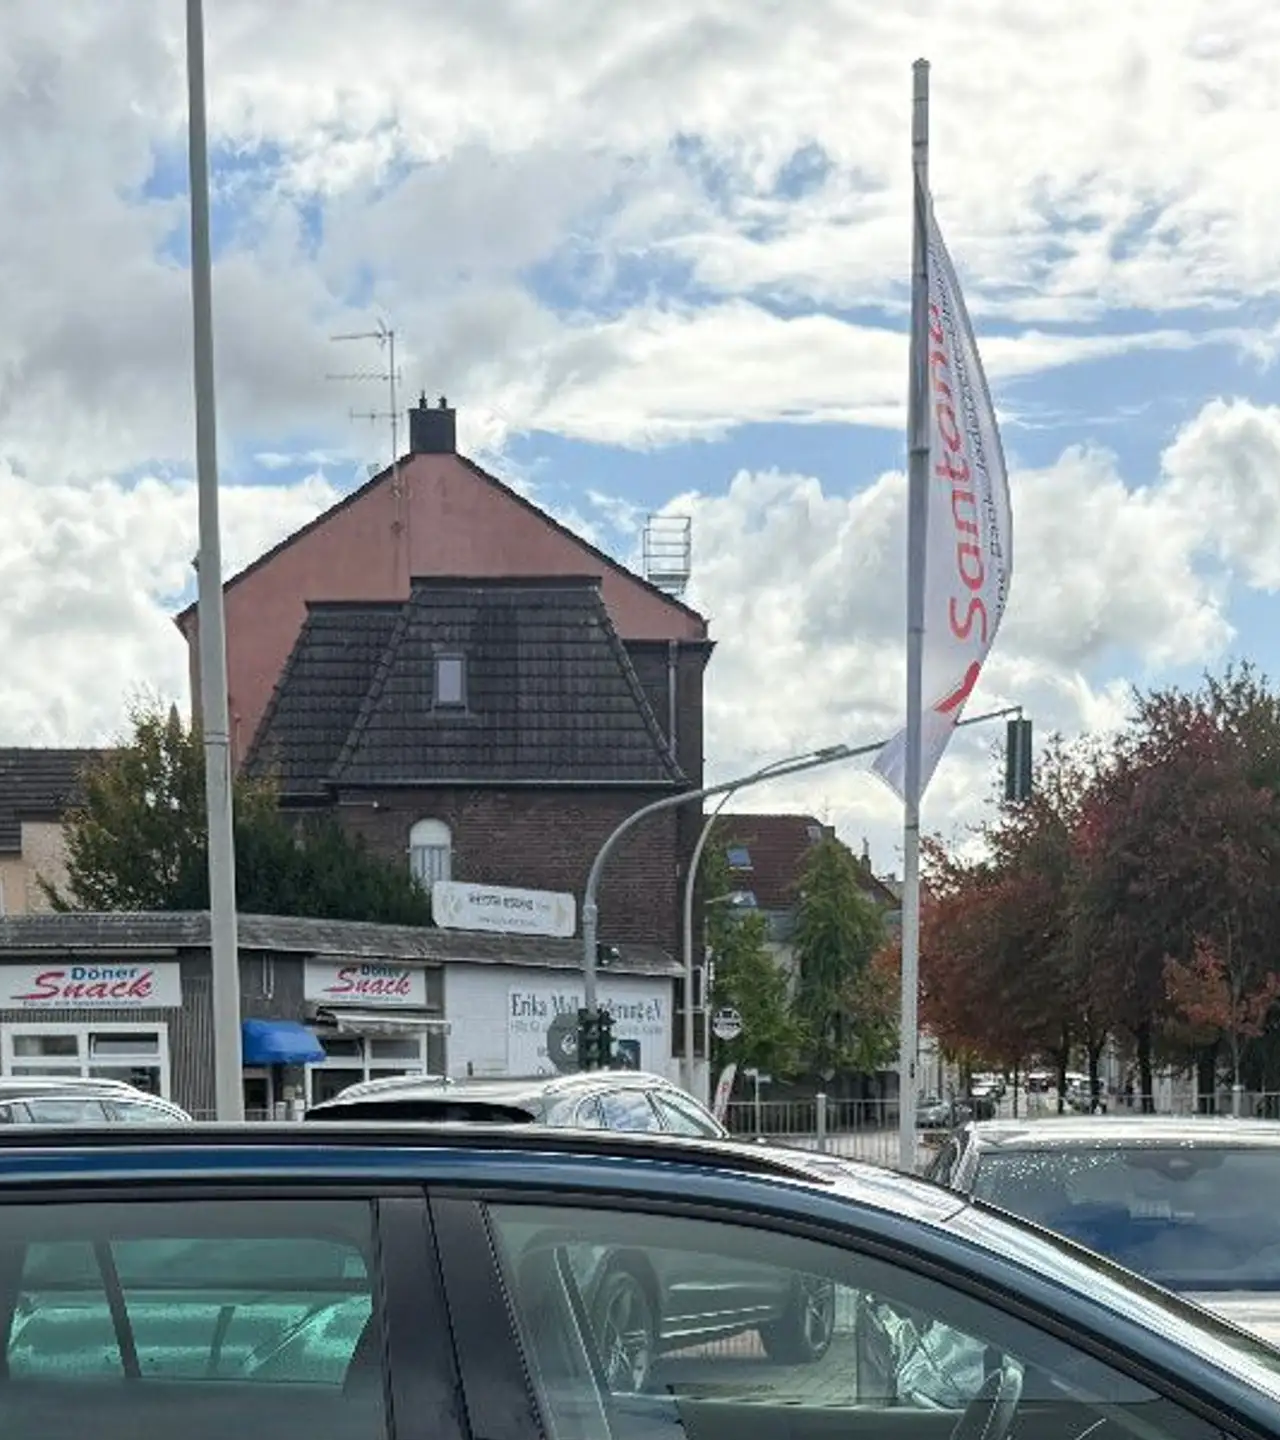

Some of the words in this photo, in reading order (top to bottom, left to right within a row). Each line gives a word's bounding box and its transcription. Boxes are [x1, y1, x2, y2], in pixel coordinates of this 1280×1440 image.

[10, 971, 153, 999] Snack
[72, 967, 138, 981] Döner
[322, 967, 411, 995] Snack
[512, 993, 547, 1017] Erika
